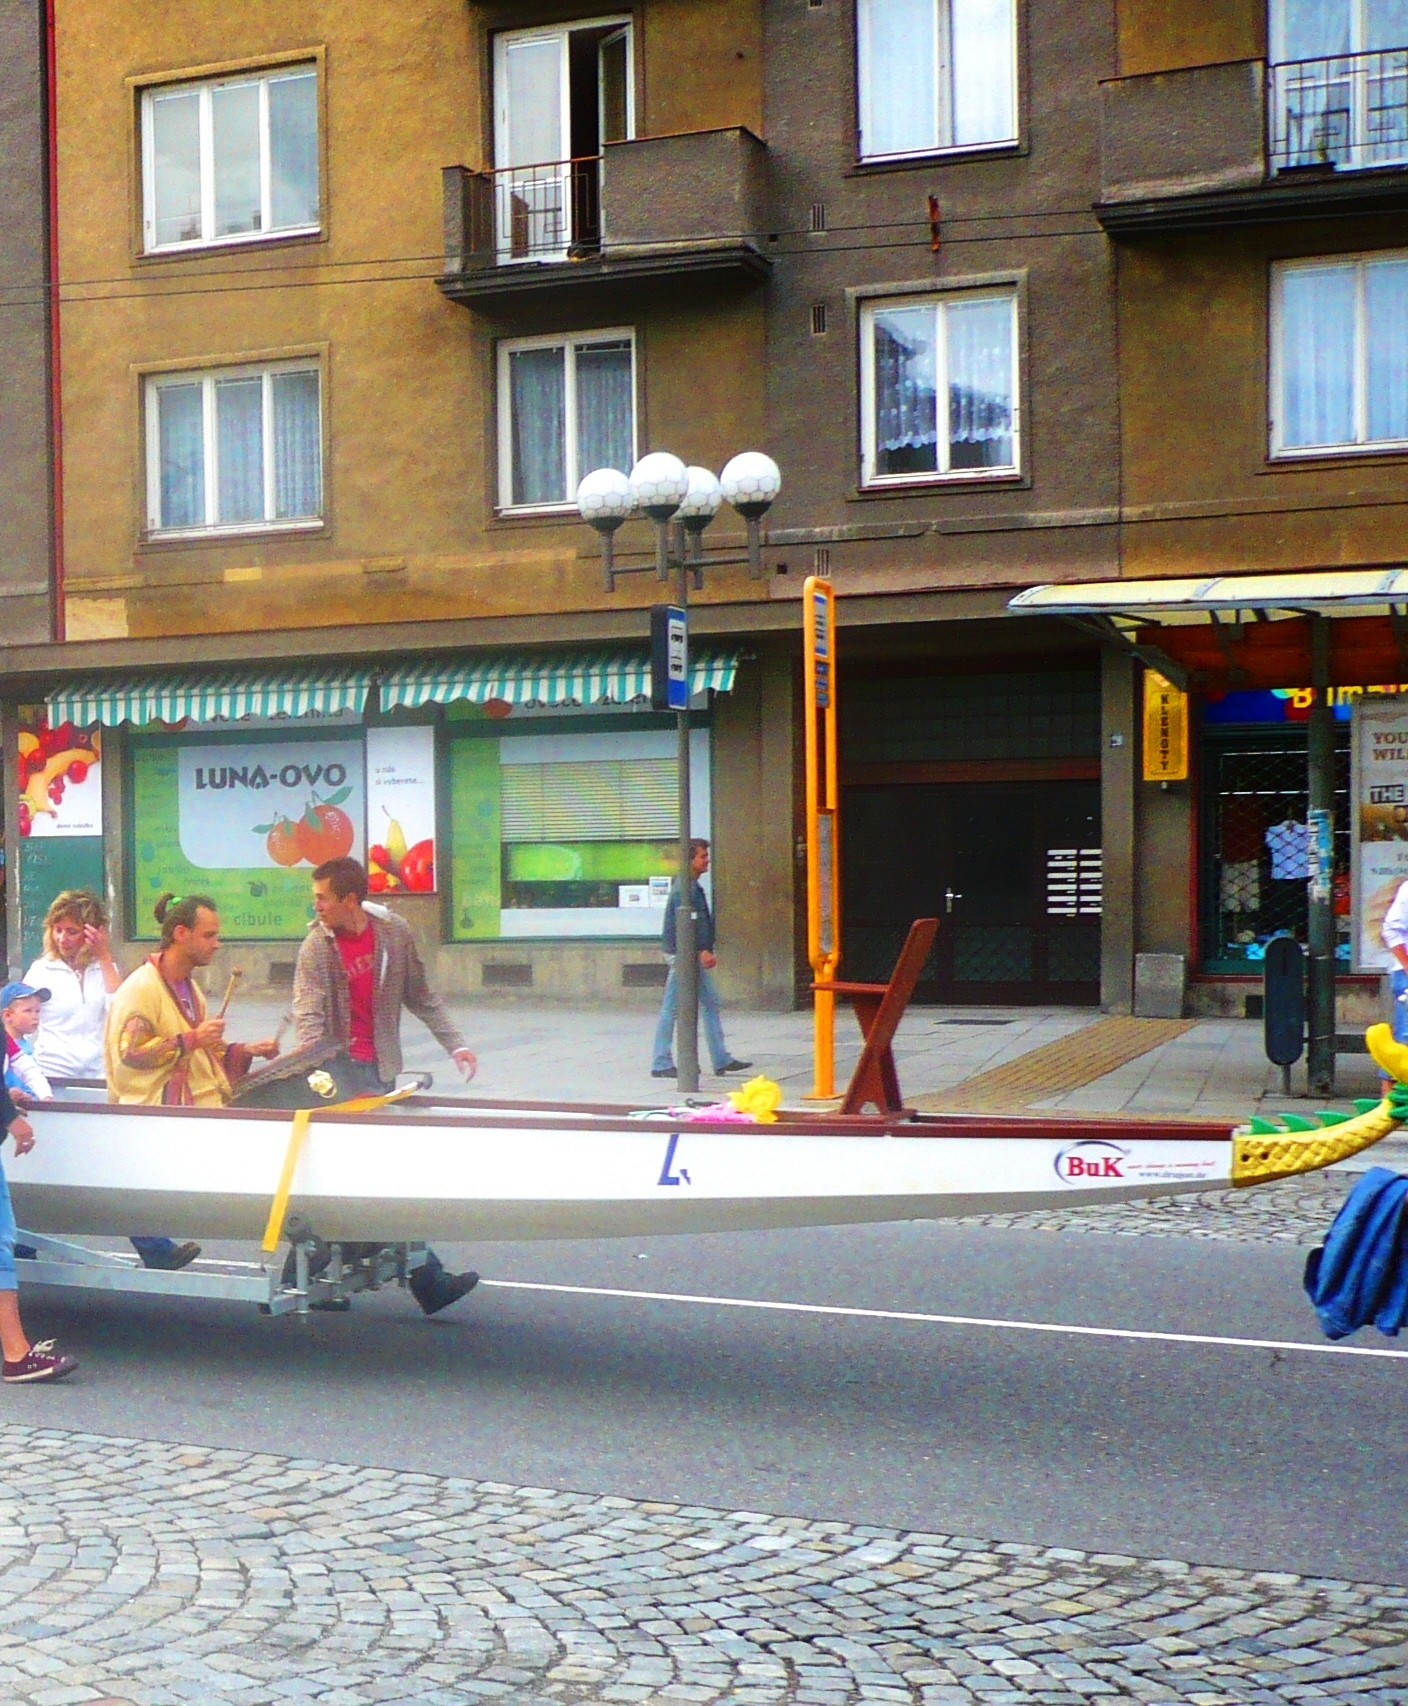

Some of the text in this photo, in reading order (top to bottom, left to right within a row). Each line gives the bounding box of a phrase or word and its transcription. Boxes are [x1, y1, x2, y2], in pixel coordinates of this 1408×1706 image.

[1372, 748, 1408, 761] WIL
[195, 763, 347, 790] LUNA-OVO
[1370, 785, 1404, 803] THE
[233, 911, 283, 927] cibule
[1066, 1156, 1124, 1178] BuK
